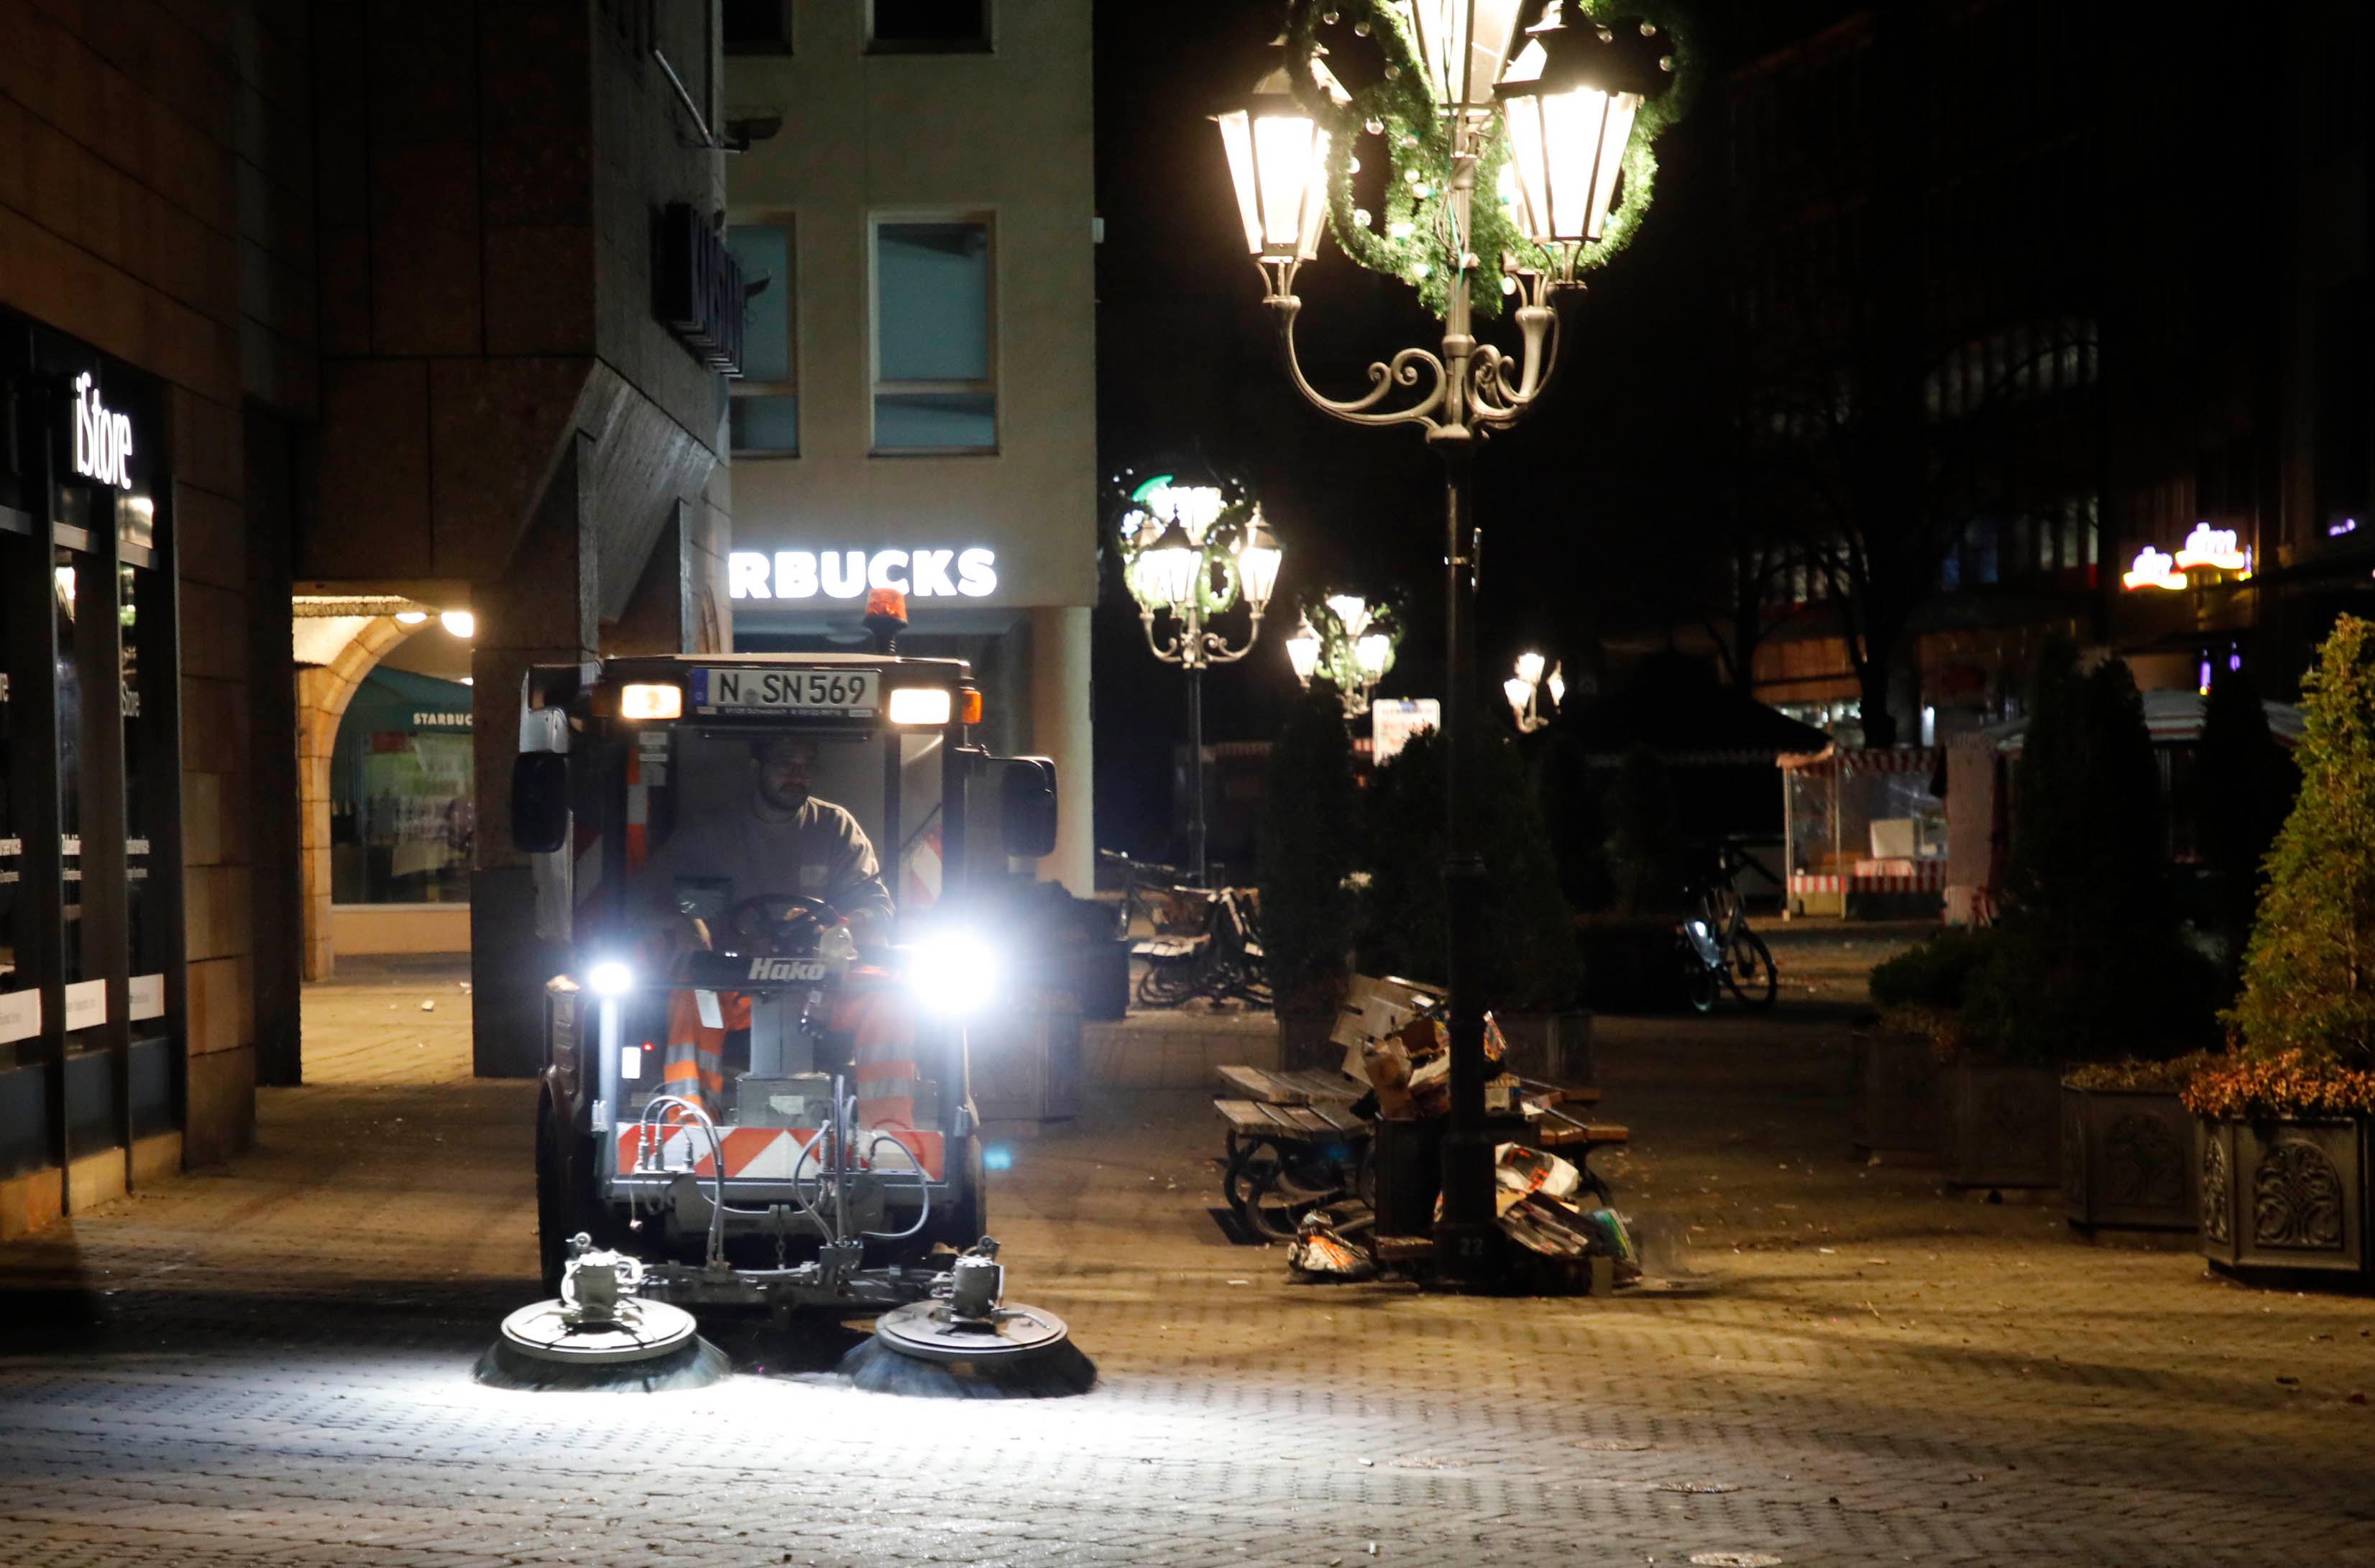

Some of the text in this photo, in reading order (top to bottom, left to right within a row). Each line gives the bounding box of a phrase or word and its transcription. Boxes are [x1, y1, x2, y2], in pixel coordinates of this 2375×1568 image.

[75, 372, 132, 490] iStore
[728, 548, 998, 599] RBUCKS
[720, 673, 738, 701] N
[413, 713, 473, 726] STARBUC
[748, 958, 826, 981] Hako
